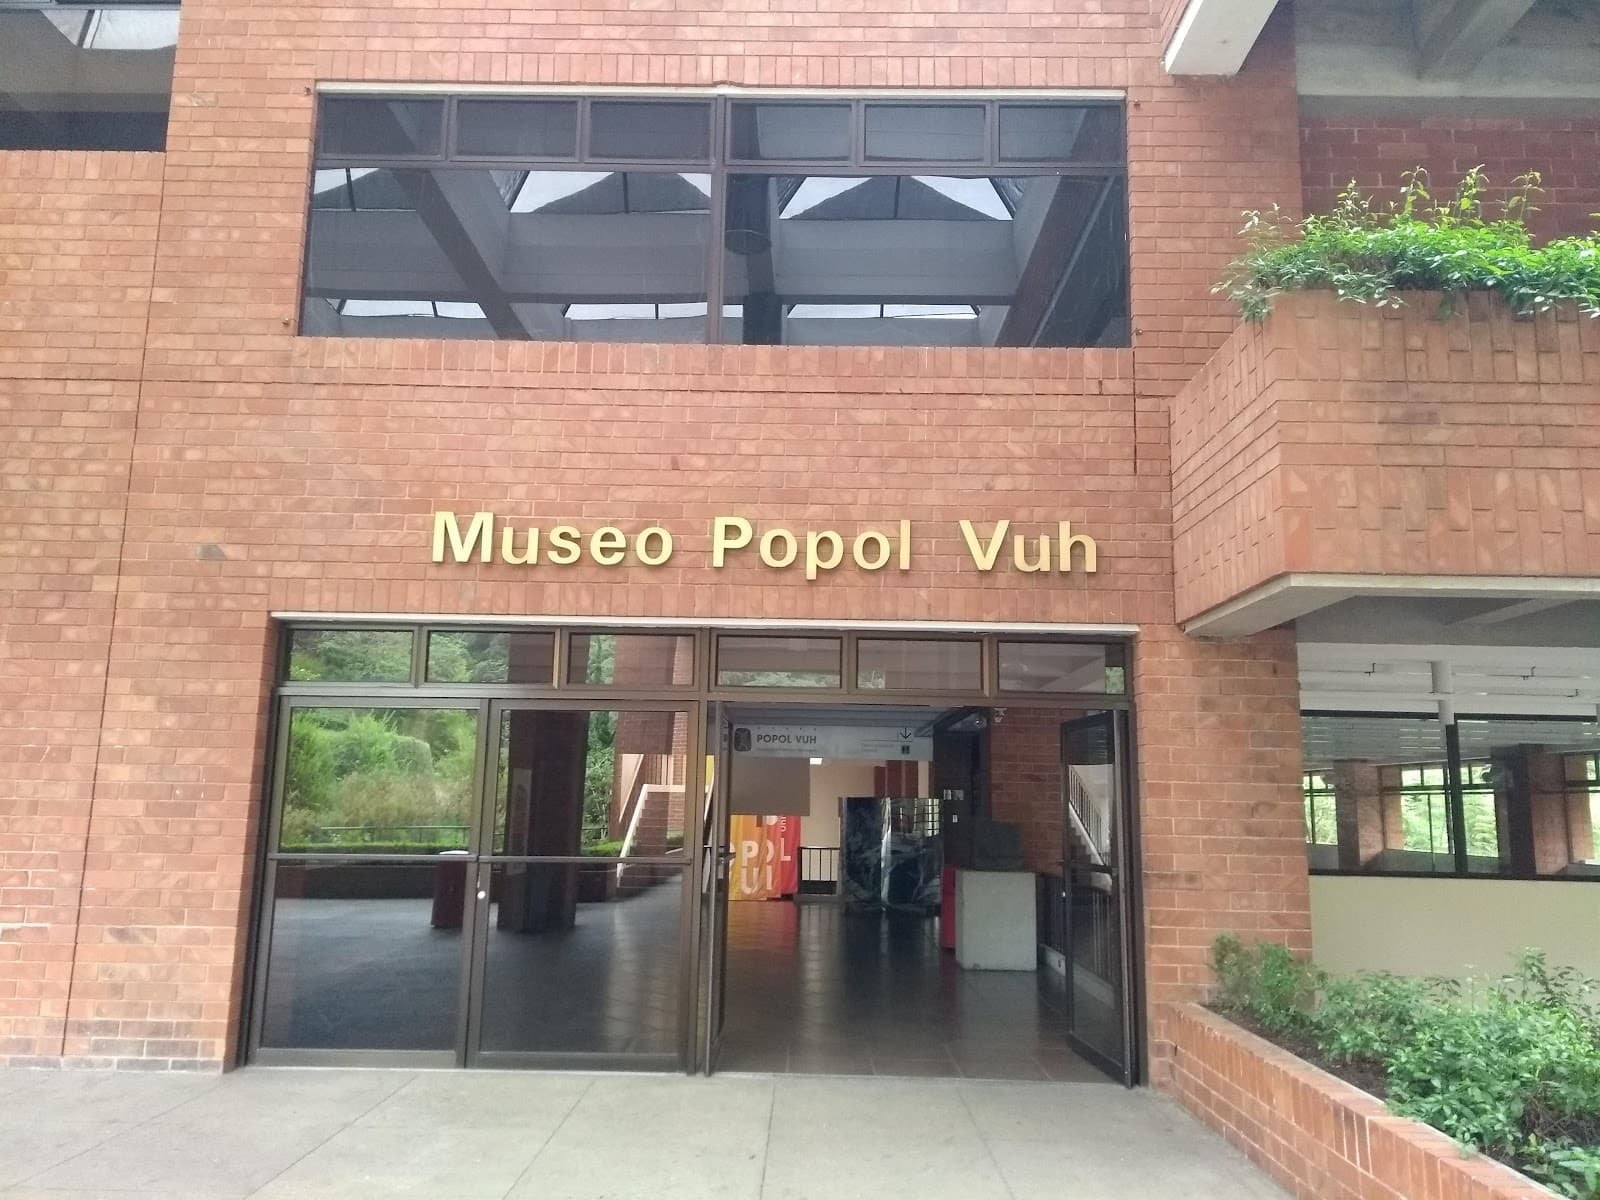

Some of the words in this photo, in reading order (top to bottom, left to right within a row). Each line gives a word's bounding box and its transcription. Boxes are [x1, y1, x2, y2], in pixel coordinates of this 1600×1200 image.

[432, 511, 673, 566] Museo
[712, 516, 911, 581] Popol
[958, 519, 1097, 573] Vuh
[756, 734, 793, 744] POPOL
[795, 735, 817, 744] VUH
